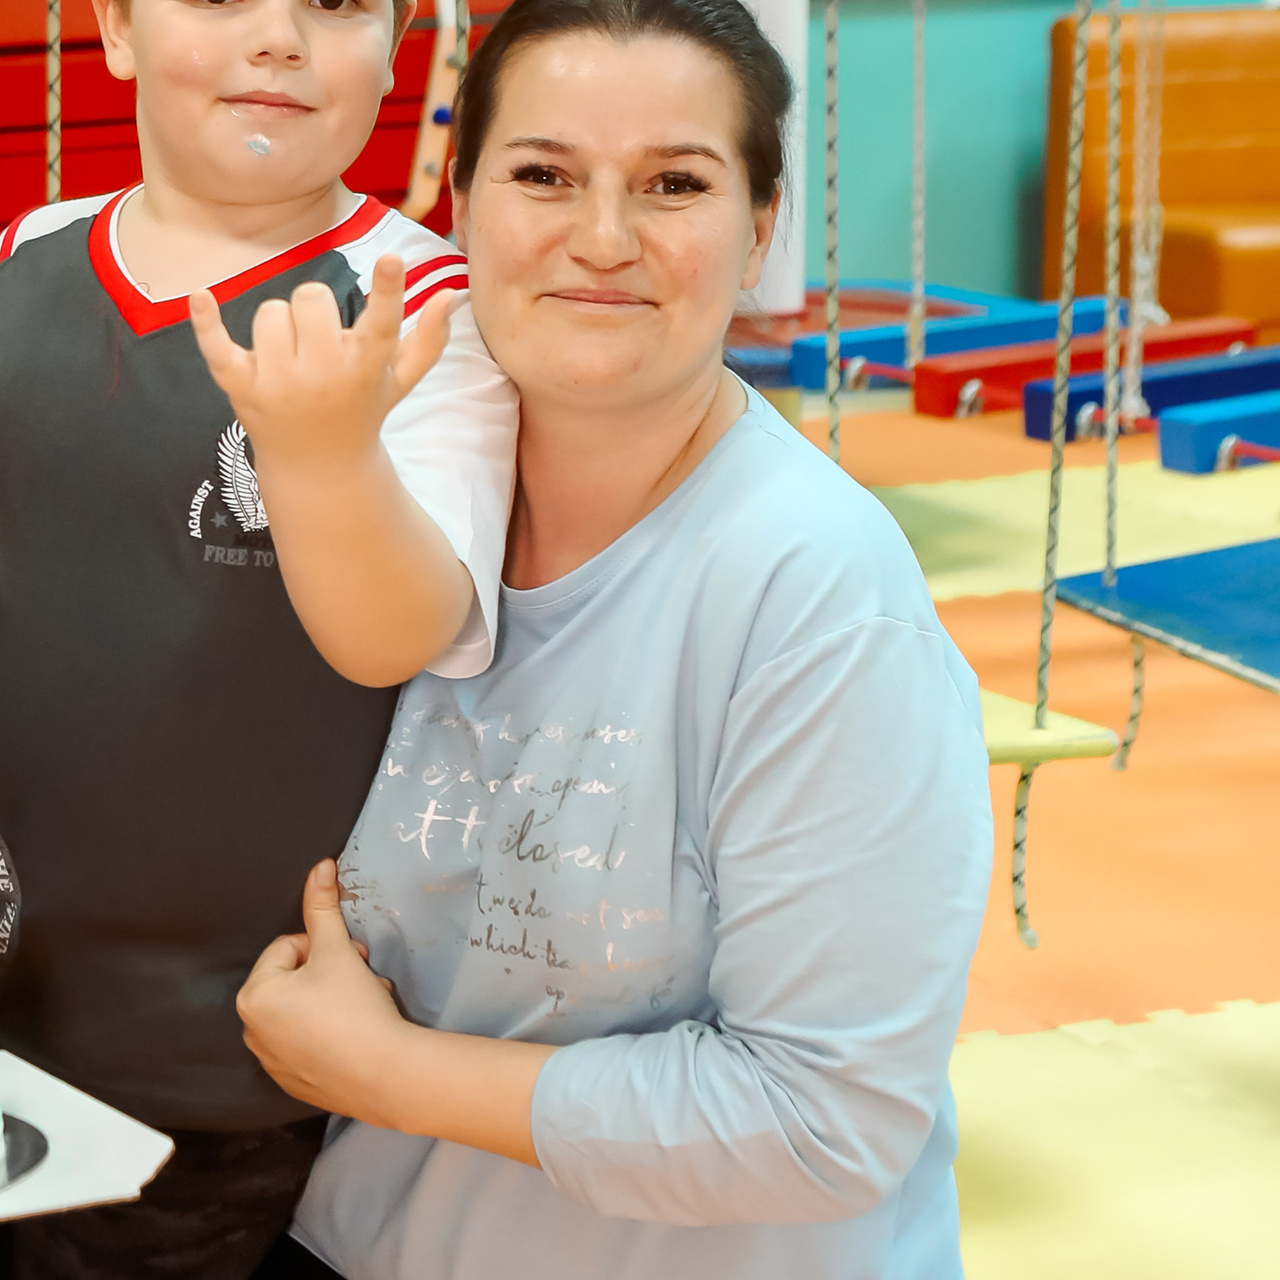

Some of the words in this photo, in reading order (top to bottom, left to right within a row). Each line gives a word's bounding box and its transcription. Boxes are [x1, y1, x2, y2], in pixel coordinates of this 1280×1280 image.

[187, 479, 215, 540] AGAINST
[203, 544, 249, 567] FREE
[253, 550, 275, 568] TO
[470, 923, 537, 960] which
